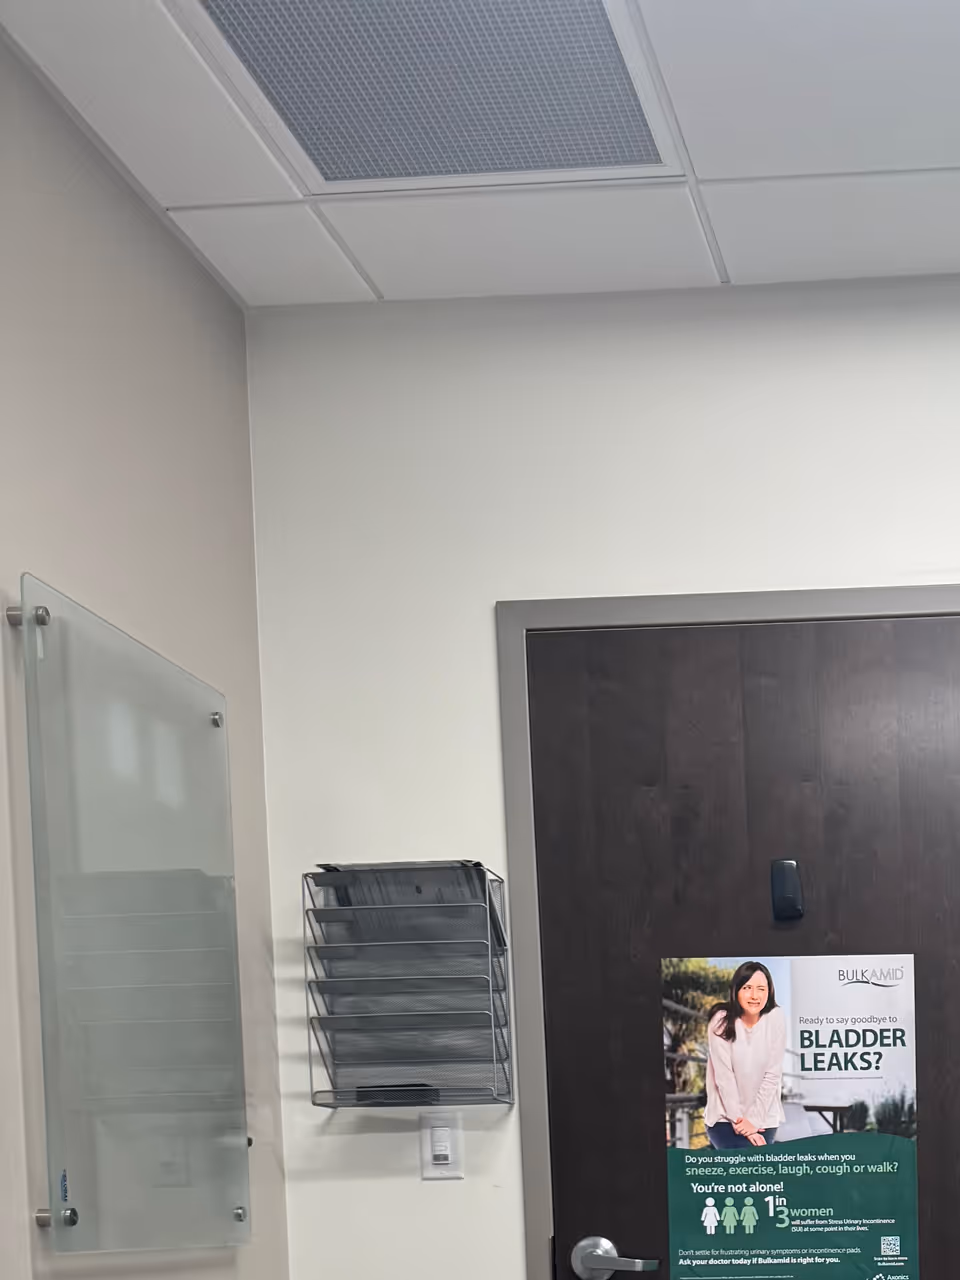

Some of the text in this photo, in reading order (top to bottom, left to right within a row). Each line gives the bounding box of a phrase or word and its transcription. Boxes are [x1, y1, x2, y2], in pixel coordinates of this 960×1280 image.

[838, 967, 904, 982] BULKAMID
[799, 1016, 824, 1026] Ready
[826, 1016, 834, 1024] to
[836, 1017, 849, 1026] say
[850, 1015, 887, 1026] goodbye
[800, 1028, 907, 1049] BLADDER
[800, 1051, 883, 1072] LEAKS?
[685, 1153, 856, 1165] Do you struggle with bladder leaks when you
[685, 1161, 898, 1177] sneeze, exercise, laugh, cough or walk?
[691, 1181, 784, 1193] You're not alone!
[764, 1195, 787, 1217] 1 in
[775, 1206, 834, 1228] 3 women
[720, 1248, 749, 1257] frustrating
[750, 1248, 771, 1257] urinary
[771, 1248, 801, 1256] symptoms
[732, 1257, 751, 1266] today
[797, 1256, 814, 1265] right
[825, 1257, 840, 1265] you.
[887, 1273, 909, 1280] Axonics
